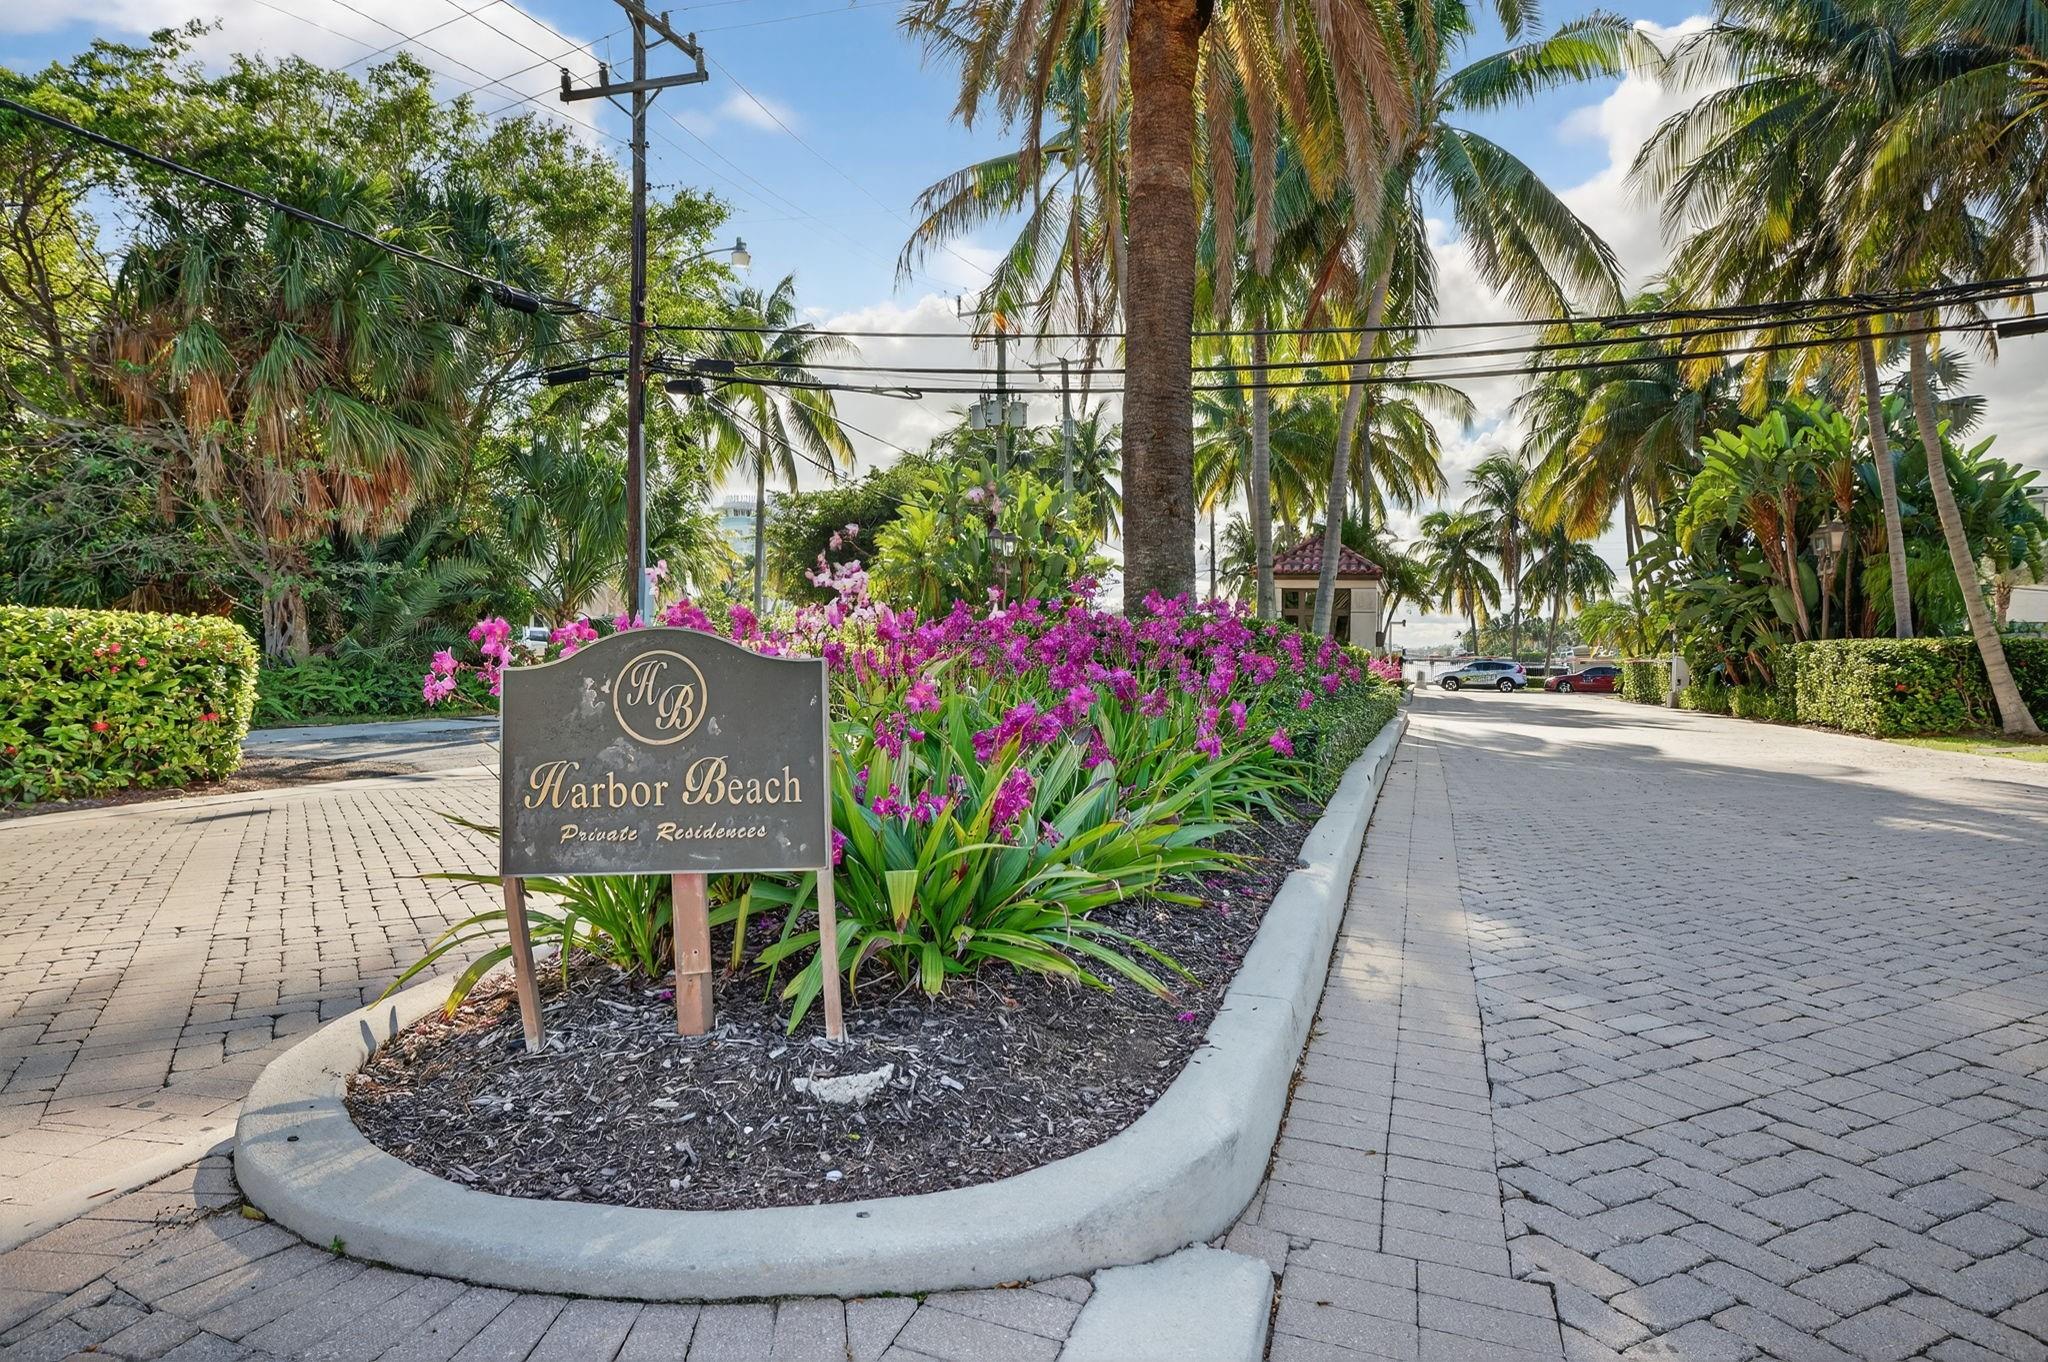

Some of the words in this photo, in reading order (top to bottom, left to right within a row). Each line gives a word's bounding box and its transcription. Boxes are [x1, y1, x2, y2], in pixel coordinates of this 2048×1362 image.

[524, 760, 669, 809] Harbor
[682, 755, 803, 805] Beach
[559, 823, 638, 844] Private
[655, 821, 767, 842] Residences
